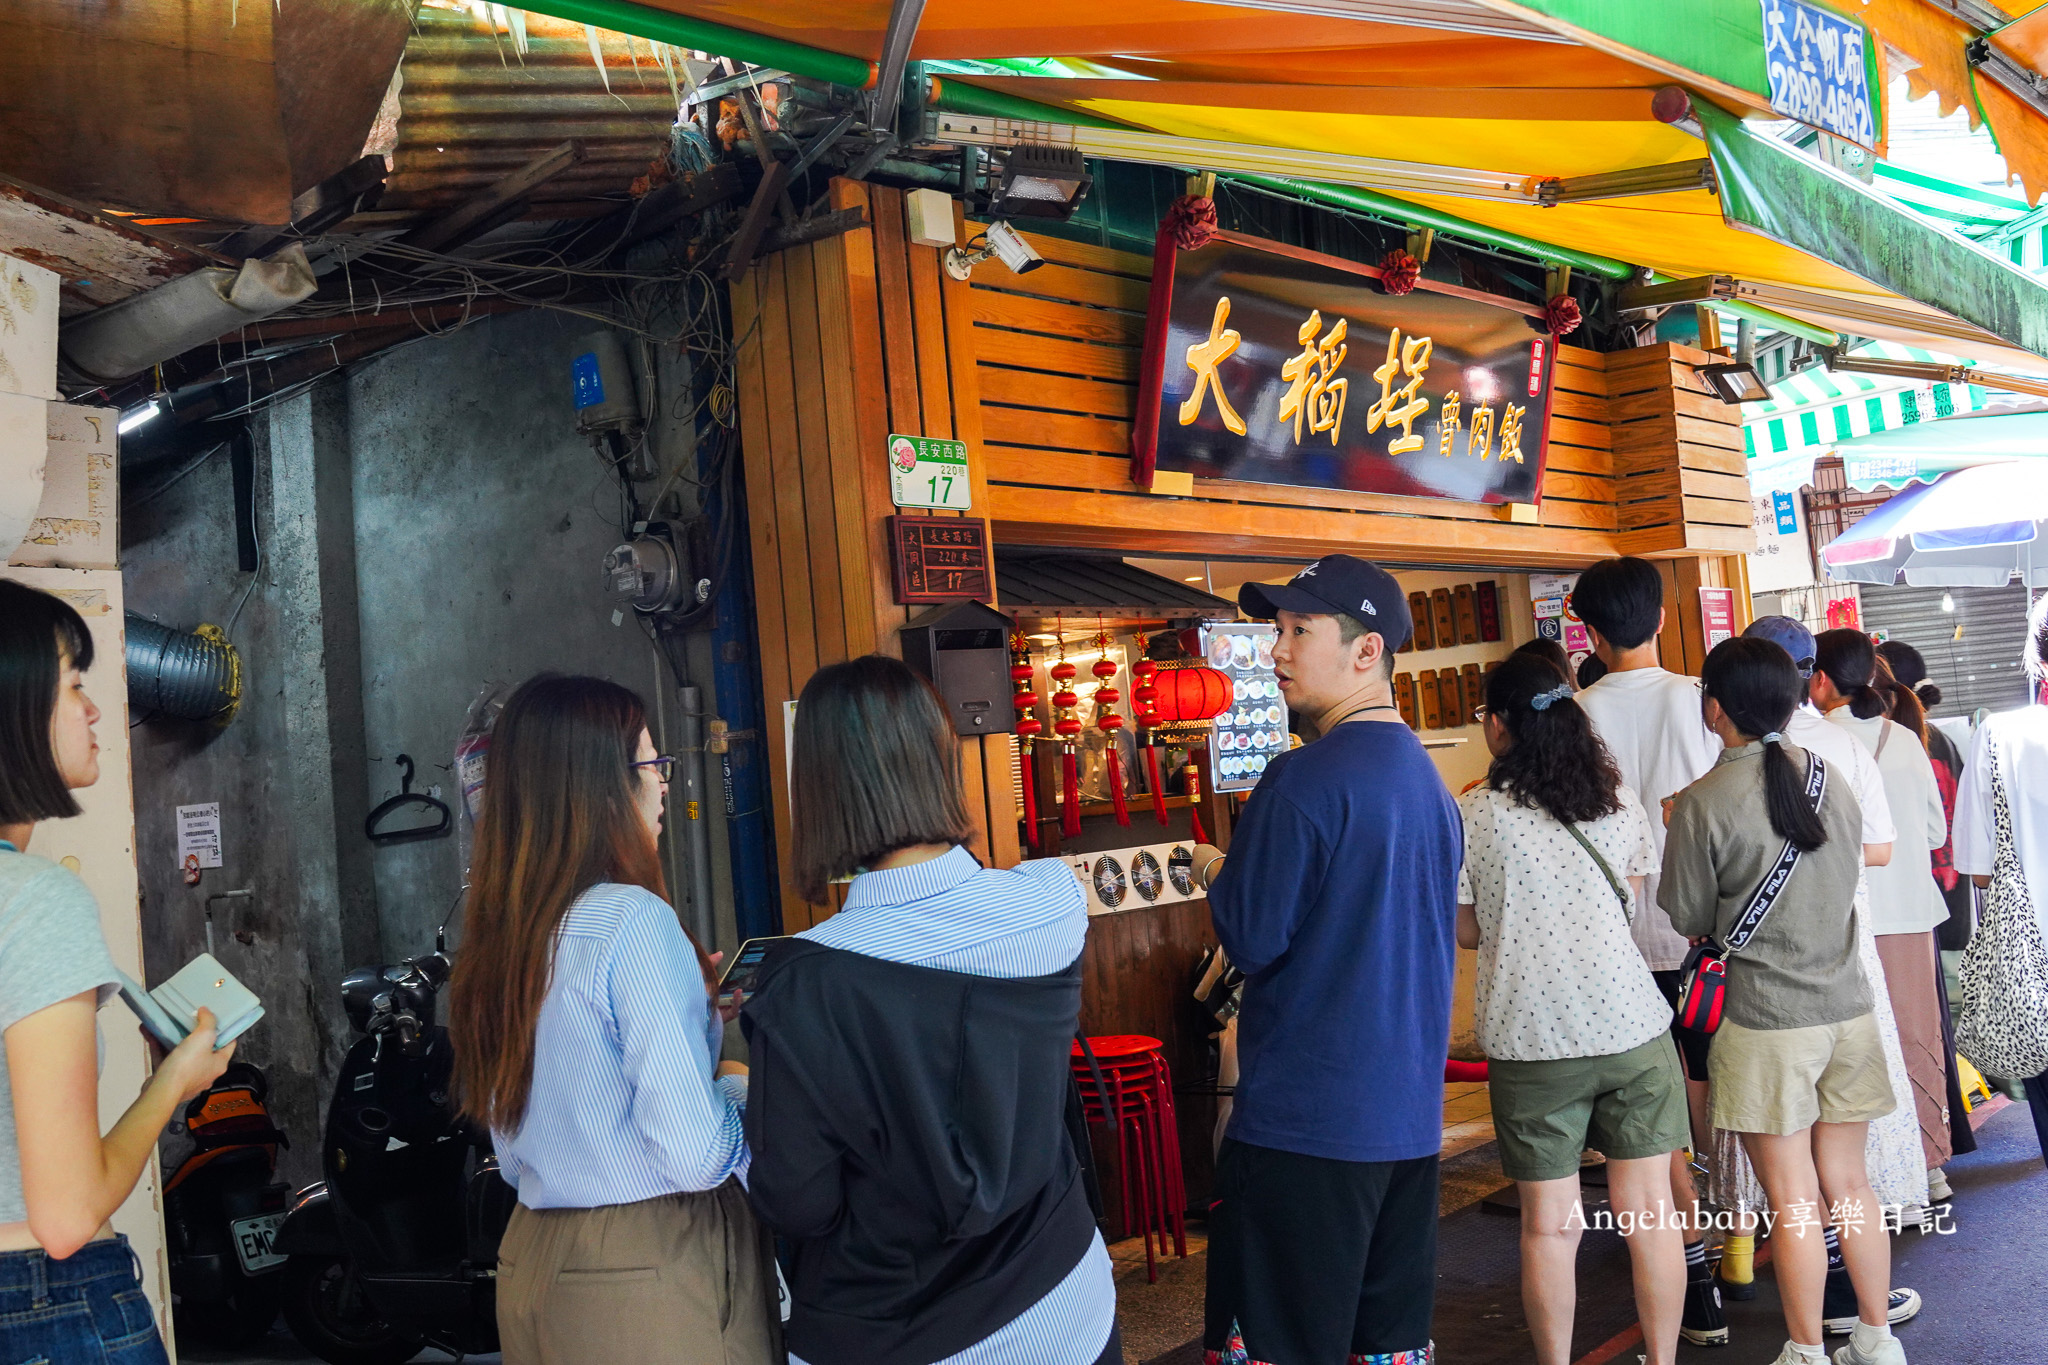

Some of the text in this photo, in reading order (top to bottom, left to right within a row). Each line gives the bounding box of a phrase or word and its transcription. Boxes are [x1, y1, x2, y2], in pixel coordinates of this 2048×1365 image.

[1767, 0, 1861, 98] 大全帆布
[1179, 296, 1433, 456] 大稻埕
[1436, 389, 1526, 464] 魯肉飯
[918, 440, 966, 460] 長安西路
[940, 465, 965, 477] 220巷
[928, 475, 953, 504] 17
[930, 529, 973, 543] 長安西路
[908, 531, 921, 587] 大同區
[947, 572, 963, 590] 17
[1810, 770, 1824, 797] FILA
[1766, 869, 1788, 896] FILA
[1747, 898, 1769, 925] FILA
